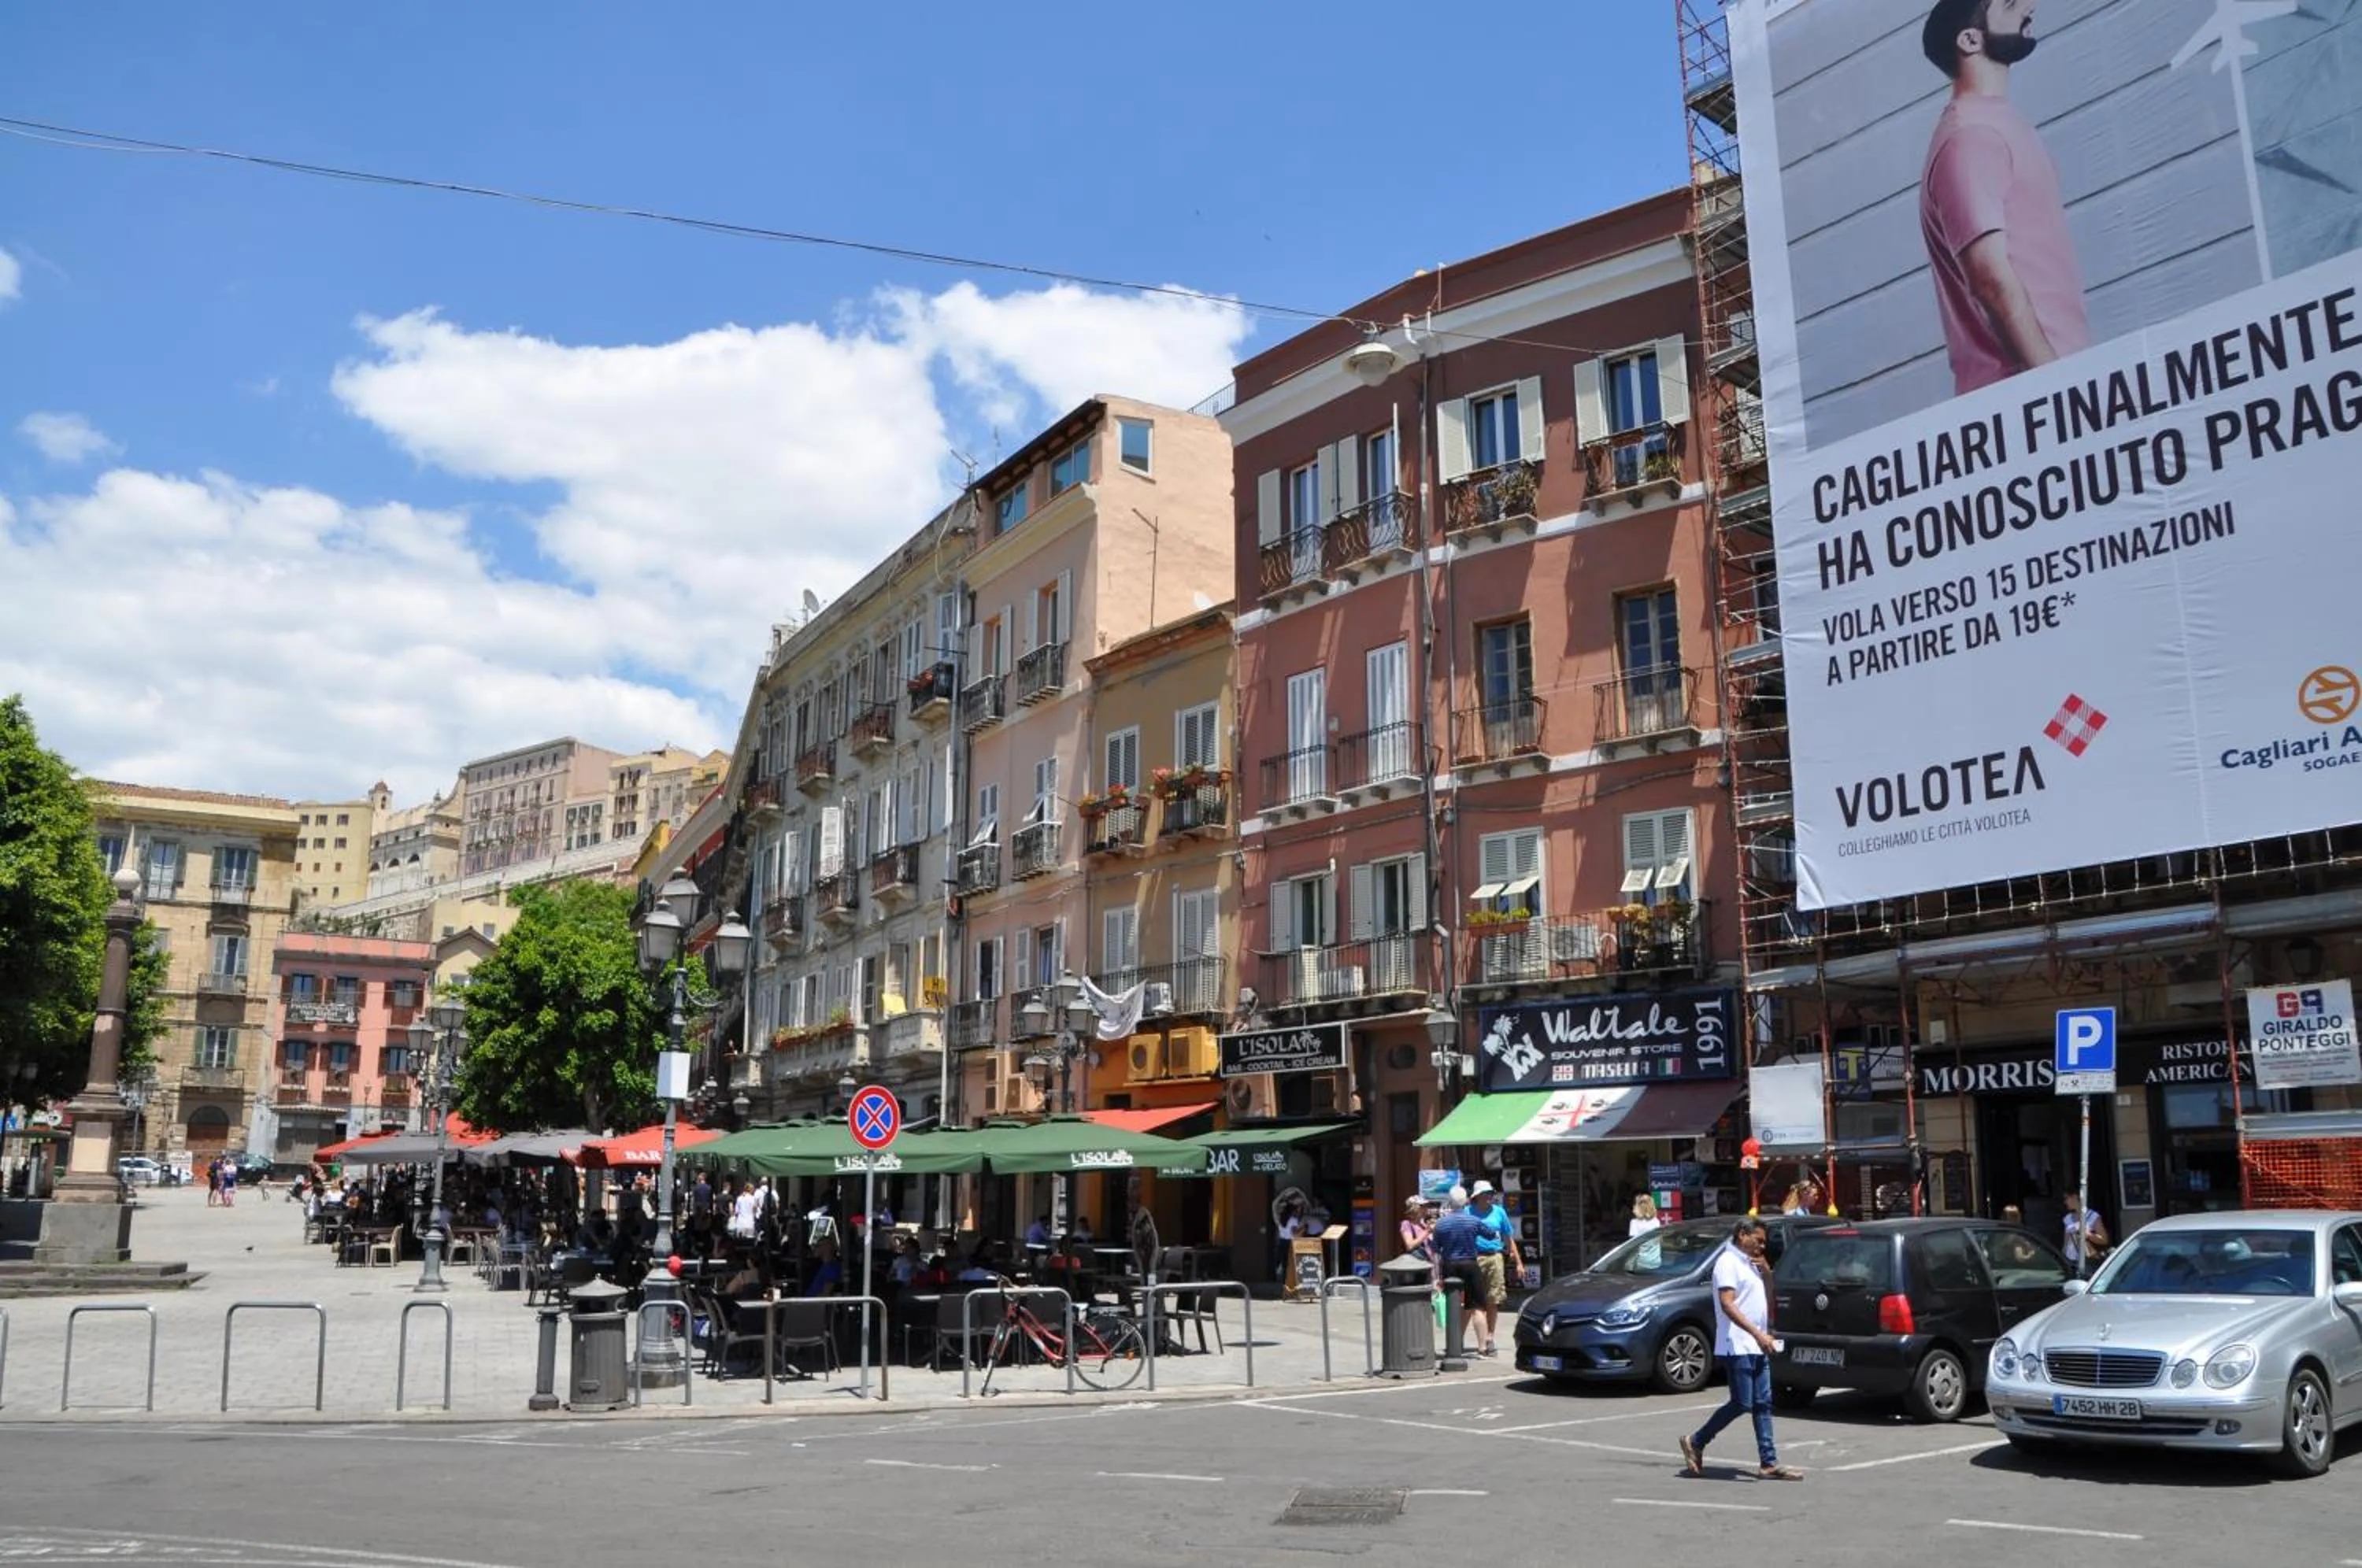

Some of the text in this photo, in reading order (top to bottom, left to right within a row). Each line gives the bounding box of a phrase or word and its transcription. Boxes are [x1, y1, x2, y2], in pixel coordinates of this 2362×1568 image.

[1813, 287, 2362, 524] CAGLIARI FINALMENTE
[1817, 530, 1875, 590] HA
[1886, 427, 2187, 568] CONOSCIUTO
[1823, 501, 2236, 645] VOLA VERSO 15 DESTINAZIONI
[1827, 656, 1843, 686] A
[1849, 623, 1957, 681] PARTIRE
[1964, 612, 2001, 650] DA
[2220, 730, 2329, 769] Cagliari
[1835, 745, 2045, 828] VOLOTEA
[1838, 829, 1919, 857] COLLEGHIAMO
[1921, 826, 1937, 843] LE
[1975, 808, 2031, 832] VOLOTEA
[1694, 996, 1727, 1071] 1991
[2067, 1015, 2103, 1066] P
[2258, 1032, 2351, 1052] PONTEGGI
[2263, 1015, 2342, 1035] GIRALDO
[1238, 1034, 1301, 1056] L'ISOLA
[1550, 1043, 1683, 1060] SOUVENIR STORE
[1246, 1060, 1287, 1071] COCKTAIL
[1922, 1059, 2054, 1094] MORRIS
[624, 1149, 661, 1160] BAR
[1207, 1148, 1240, 1174] BAR
[2063, 1399, 2137, 1415] 7452 HH 2B
